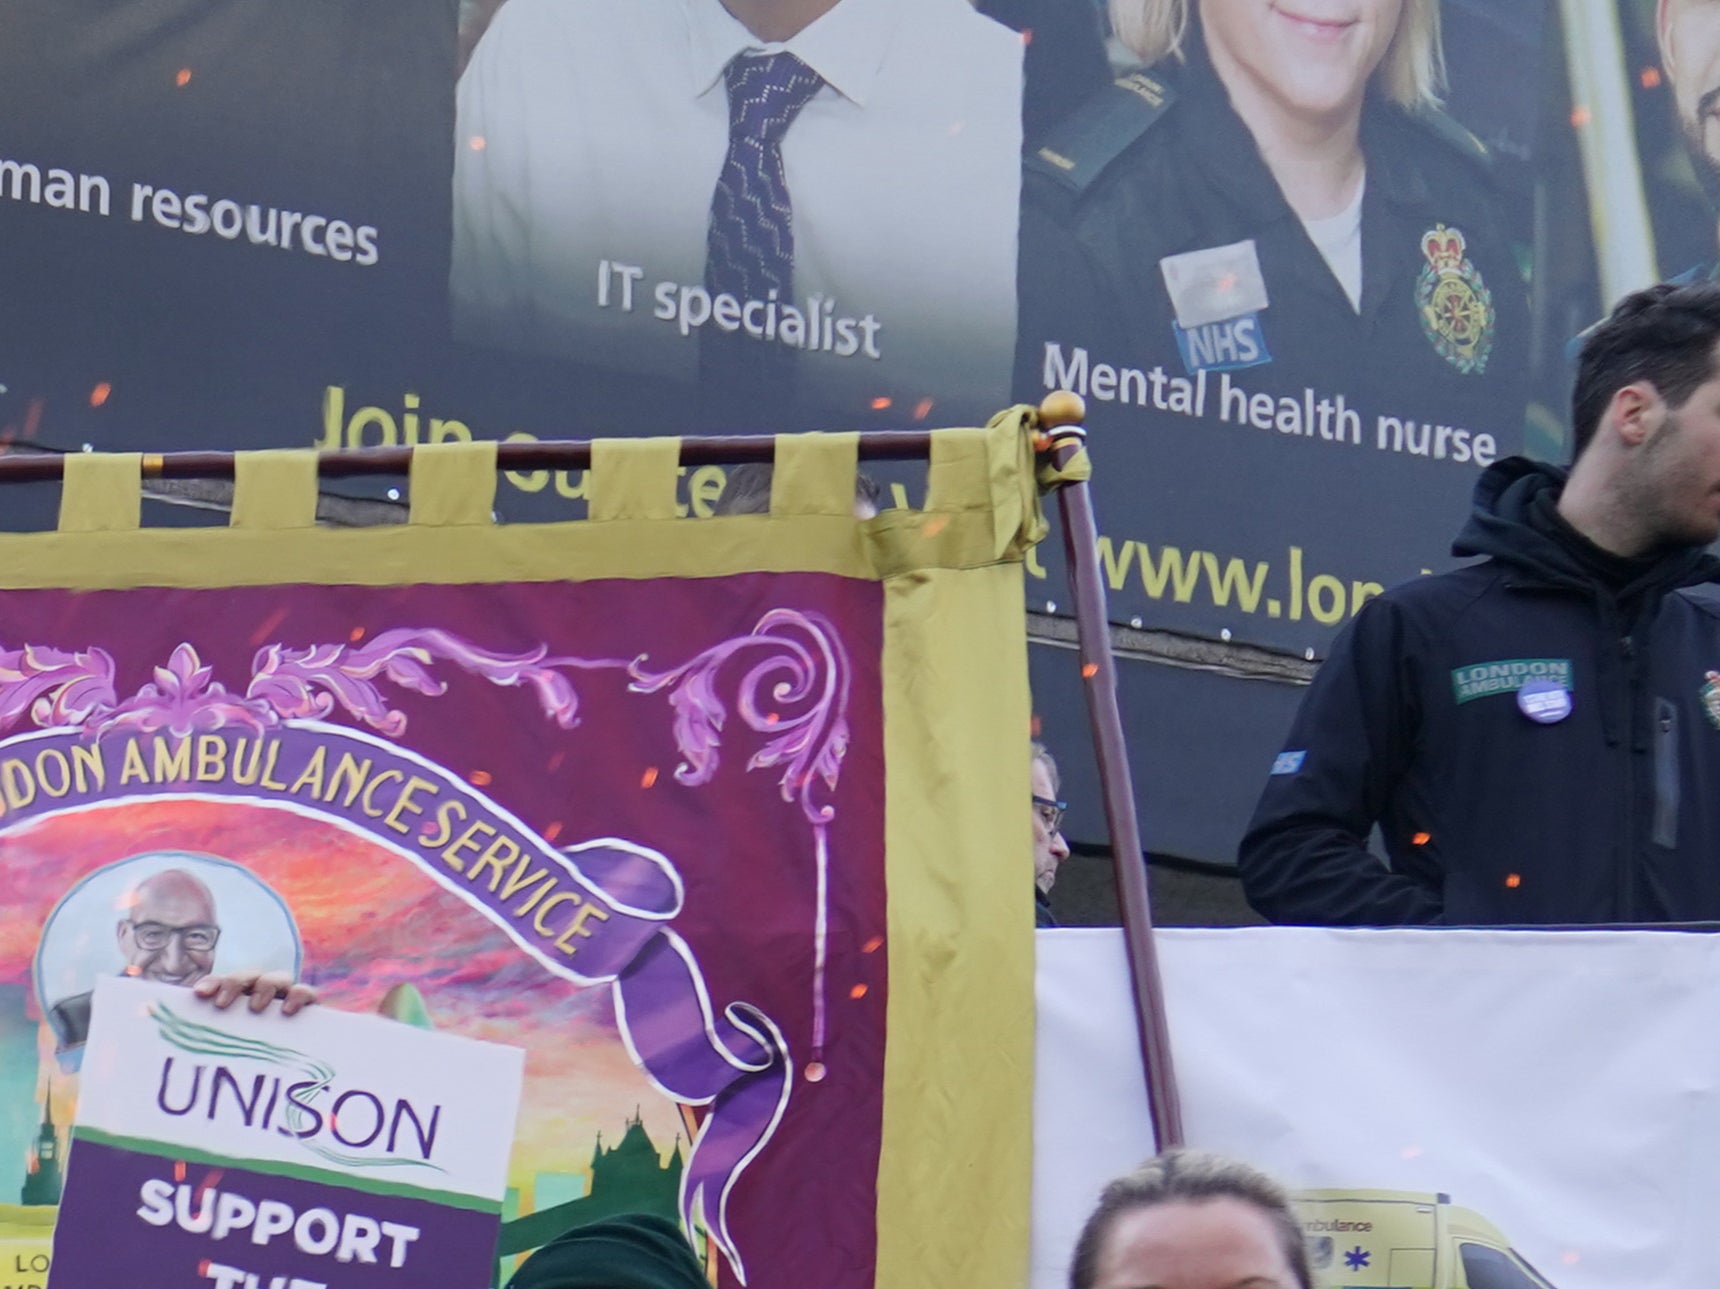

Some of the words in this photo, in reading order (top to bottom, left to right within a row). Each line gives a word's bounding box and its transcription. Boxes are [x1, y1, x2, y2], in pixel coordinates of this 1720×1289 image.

[130, 180, 379, 266] resources
[597, 260, 643, 313] IT
[655, 273, 882, 363] specialist
[1186, 319, 1260, 367] NHS
[1044, 342, 1206, 417] Mental
[1220, 373, 1361, 445] health
[1377, 415, 1497, 467] nurse
[1095, 533, 1433, 626] www.lon
[1458, 661, 1570, 685] LONDON
[1273, 752, 1306, 774] HS
[120, 734, 440, 835] AMBULANCE
[418, 799, 610, 957] SERVICE
[158, 1056, 443, 1160] UNISON
[136, 1180, 421, 1269] SUPPORT
[1306, 1219, 1373, 1233] mbulance
